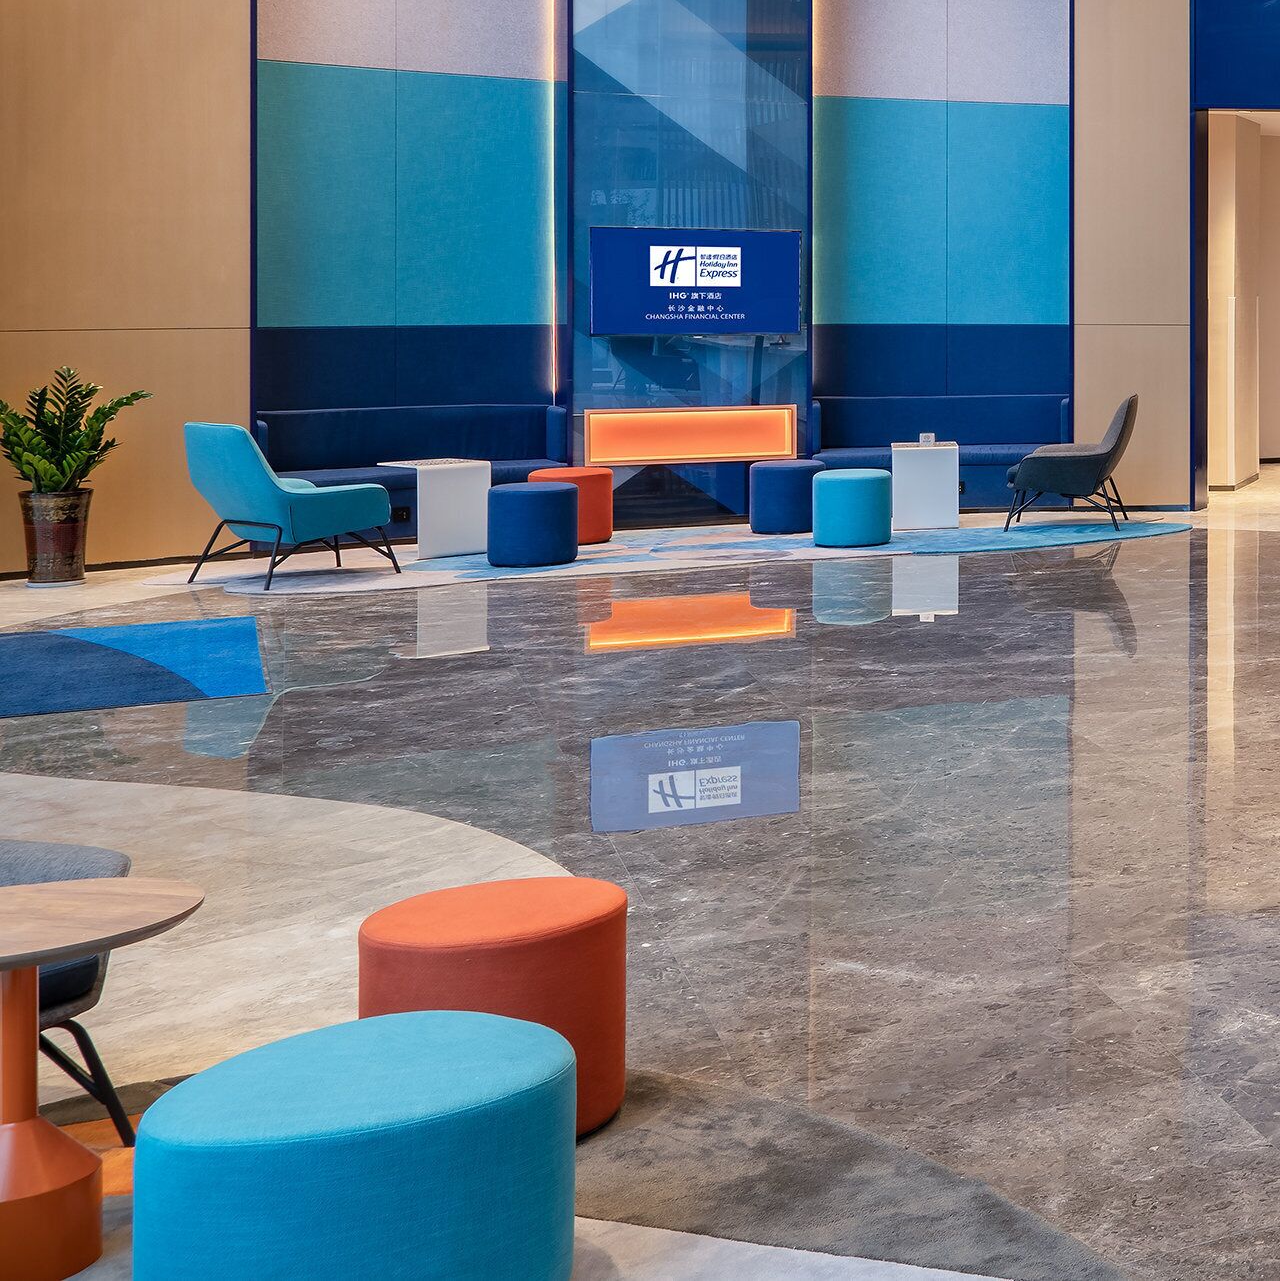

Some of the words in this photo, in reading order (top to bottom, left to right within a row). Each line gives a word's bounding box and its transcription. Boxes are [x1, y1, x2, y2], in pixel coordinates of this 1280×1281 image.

[700, 261, 726, 269] Holiday
[700, 268, 738, 279] Express
[668, 304, 724, 312] 长沙金融中心
